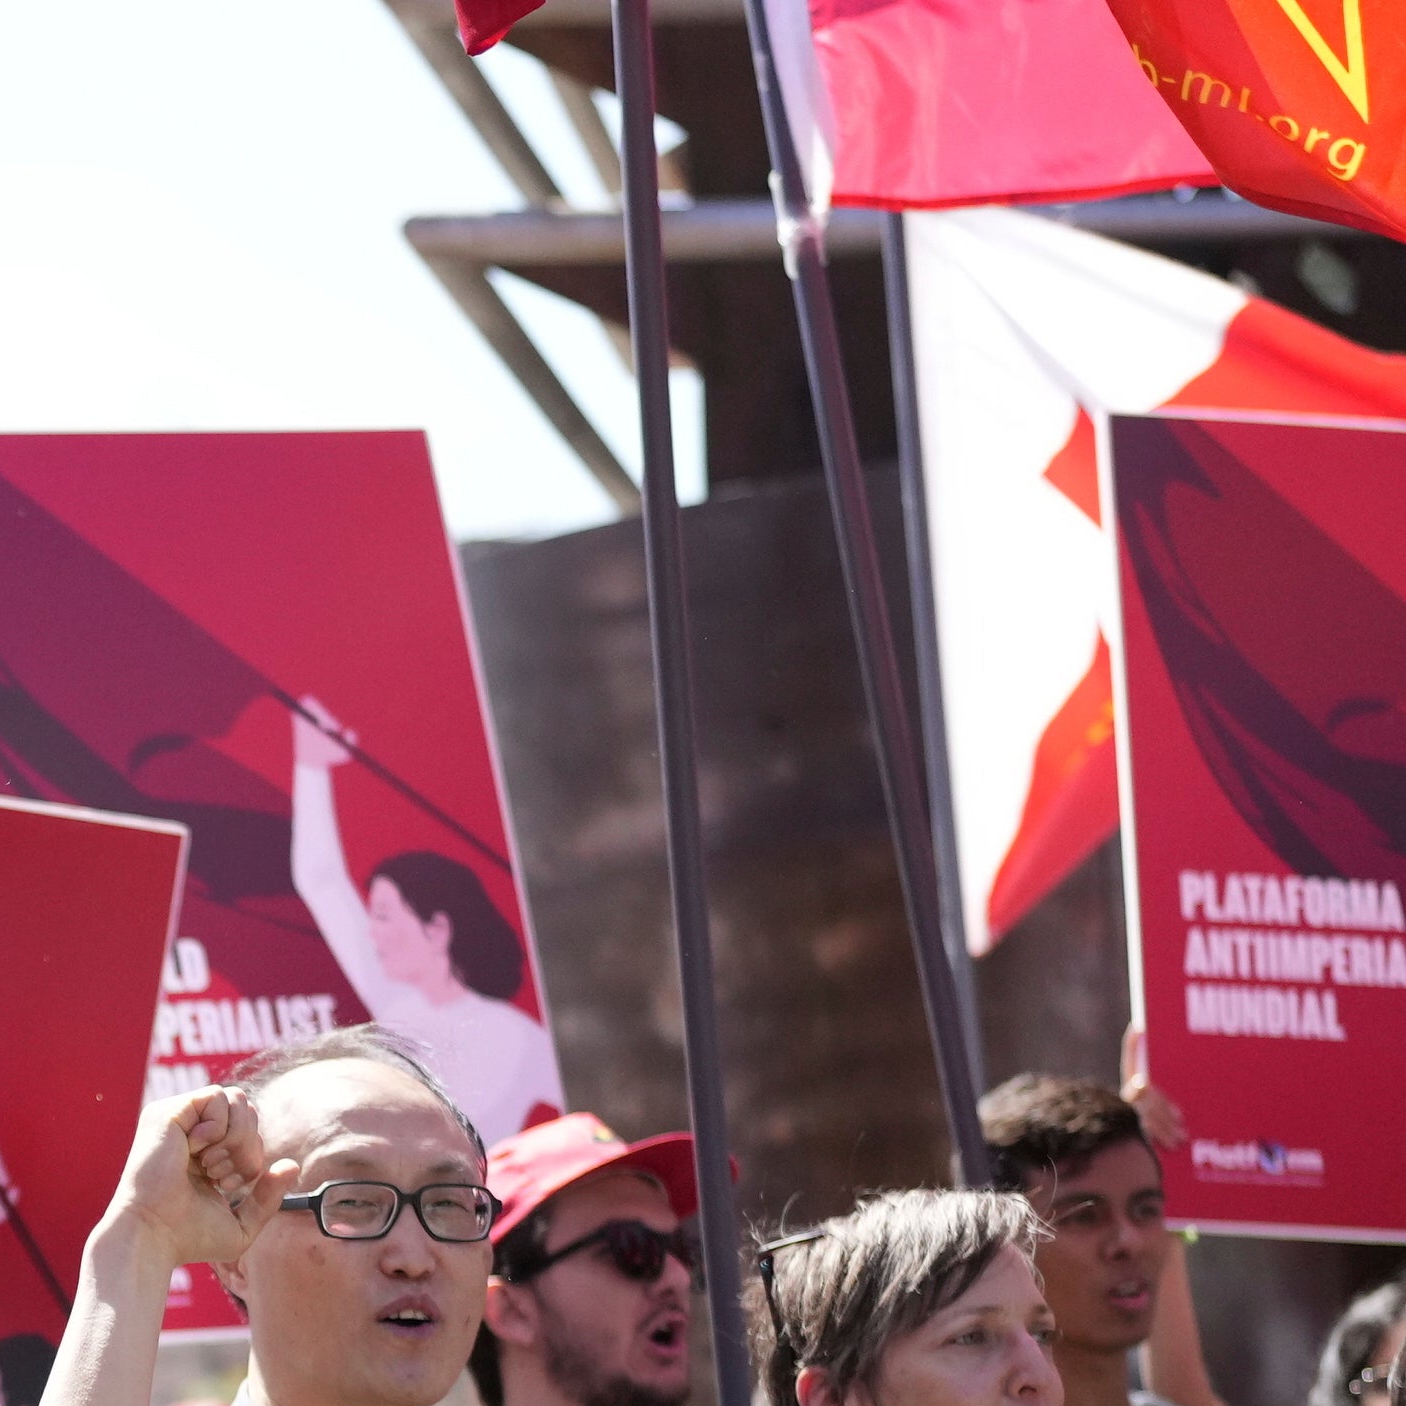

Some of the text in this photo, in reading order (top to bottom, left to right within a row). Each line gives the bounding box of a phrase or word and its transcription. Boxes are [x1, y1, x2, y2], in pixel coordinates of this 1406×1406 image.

[1178, 869, 1406, 932] PLATAFORMA
[1184, 925, 1406, 988] ANTIIMPERIA
[1186, 984, 1347, 1042] MUNDIAL
